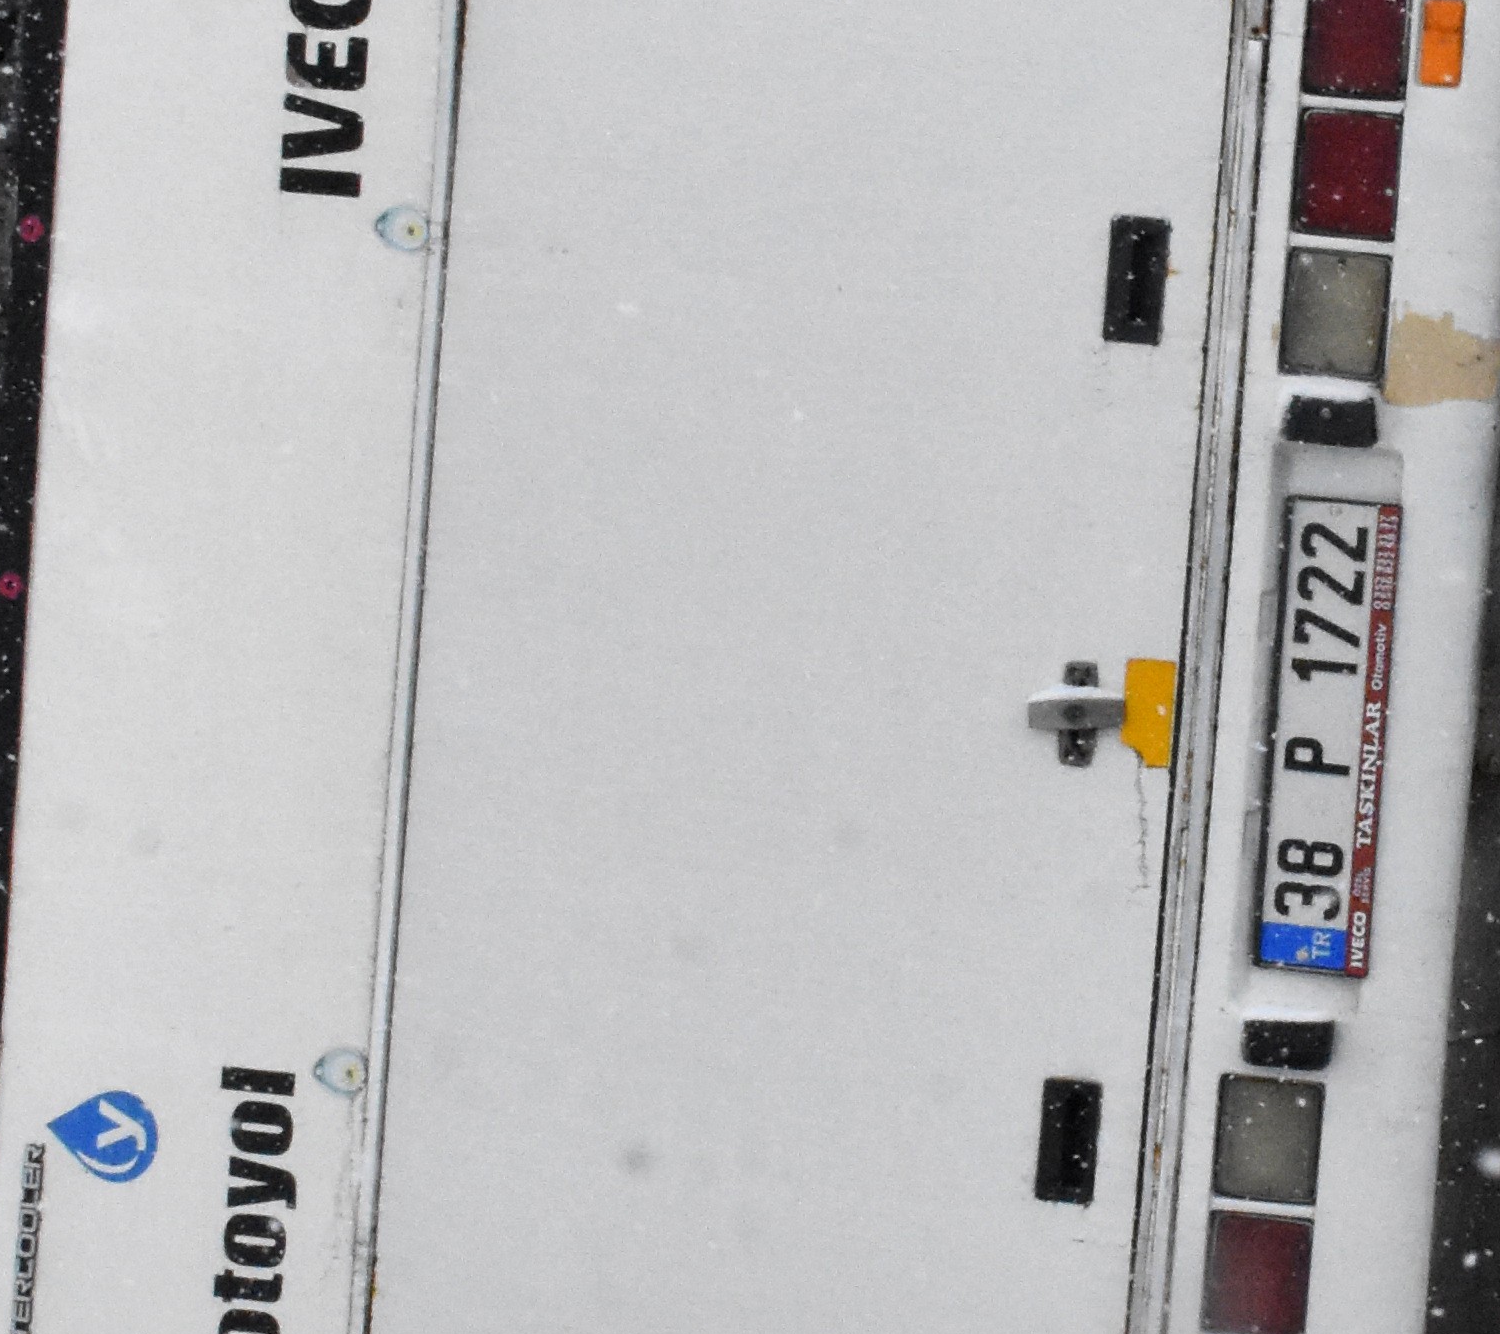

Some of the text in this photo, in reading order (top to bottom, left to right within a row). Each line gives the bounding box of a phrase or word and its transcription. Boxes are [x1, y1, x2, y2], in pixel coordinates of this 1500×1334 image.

[1274, 522, 1369, 921] 38 P 1722
[1349, 911, 1367, 969] IVECO
[1371, 623, 1387, 690] Otomotiv
[1311, 931, 1332, 960] TR
